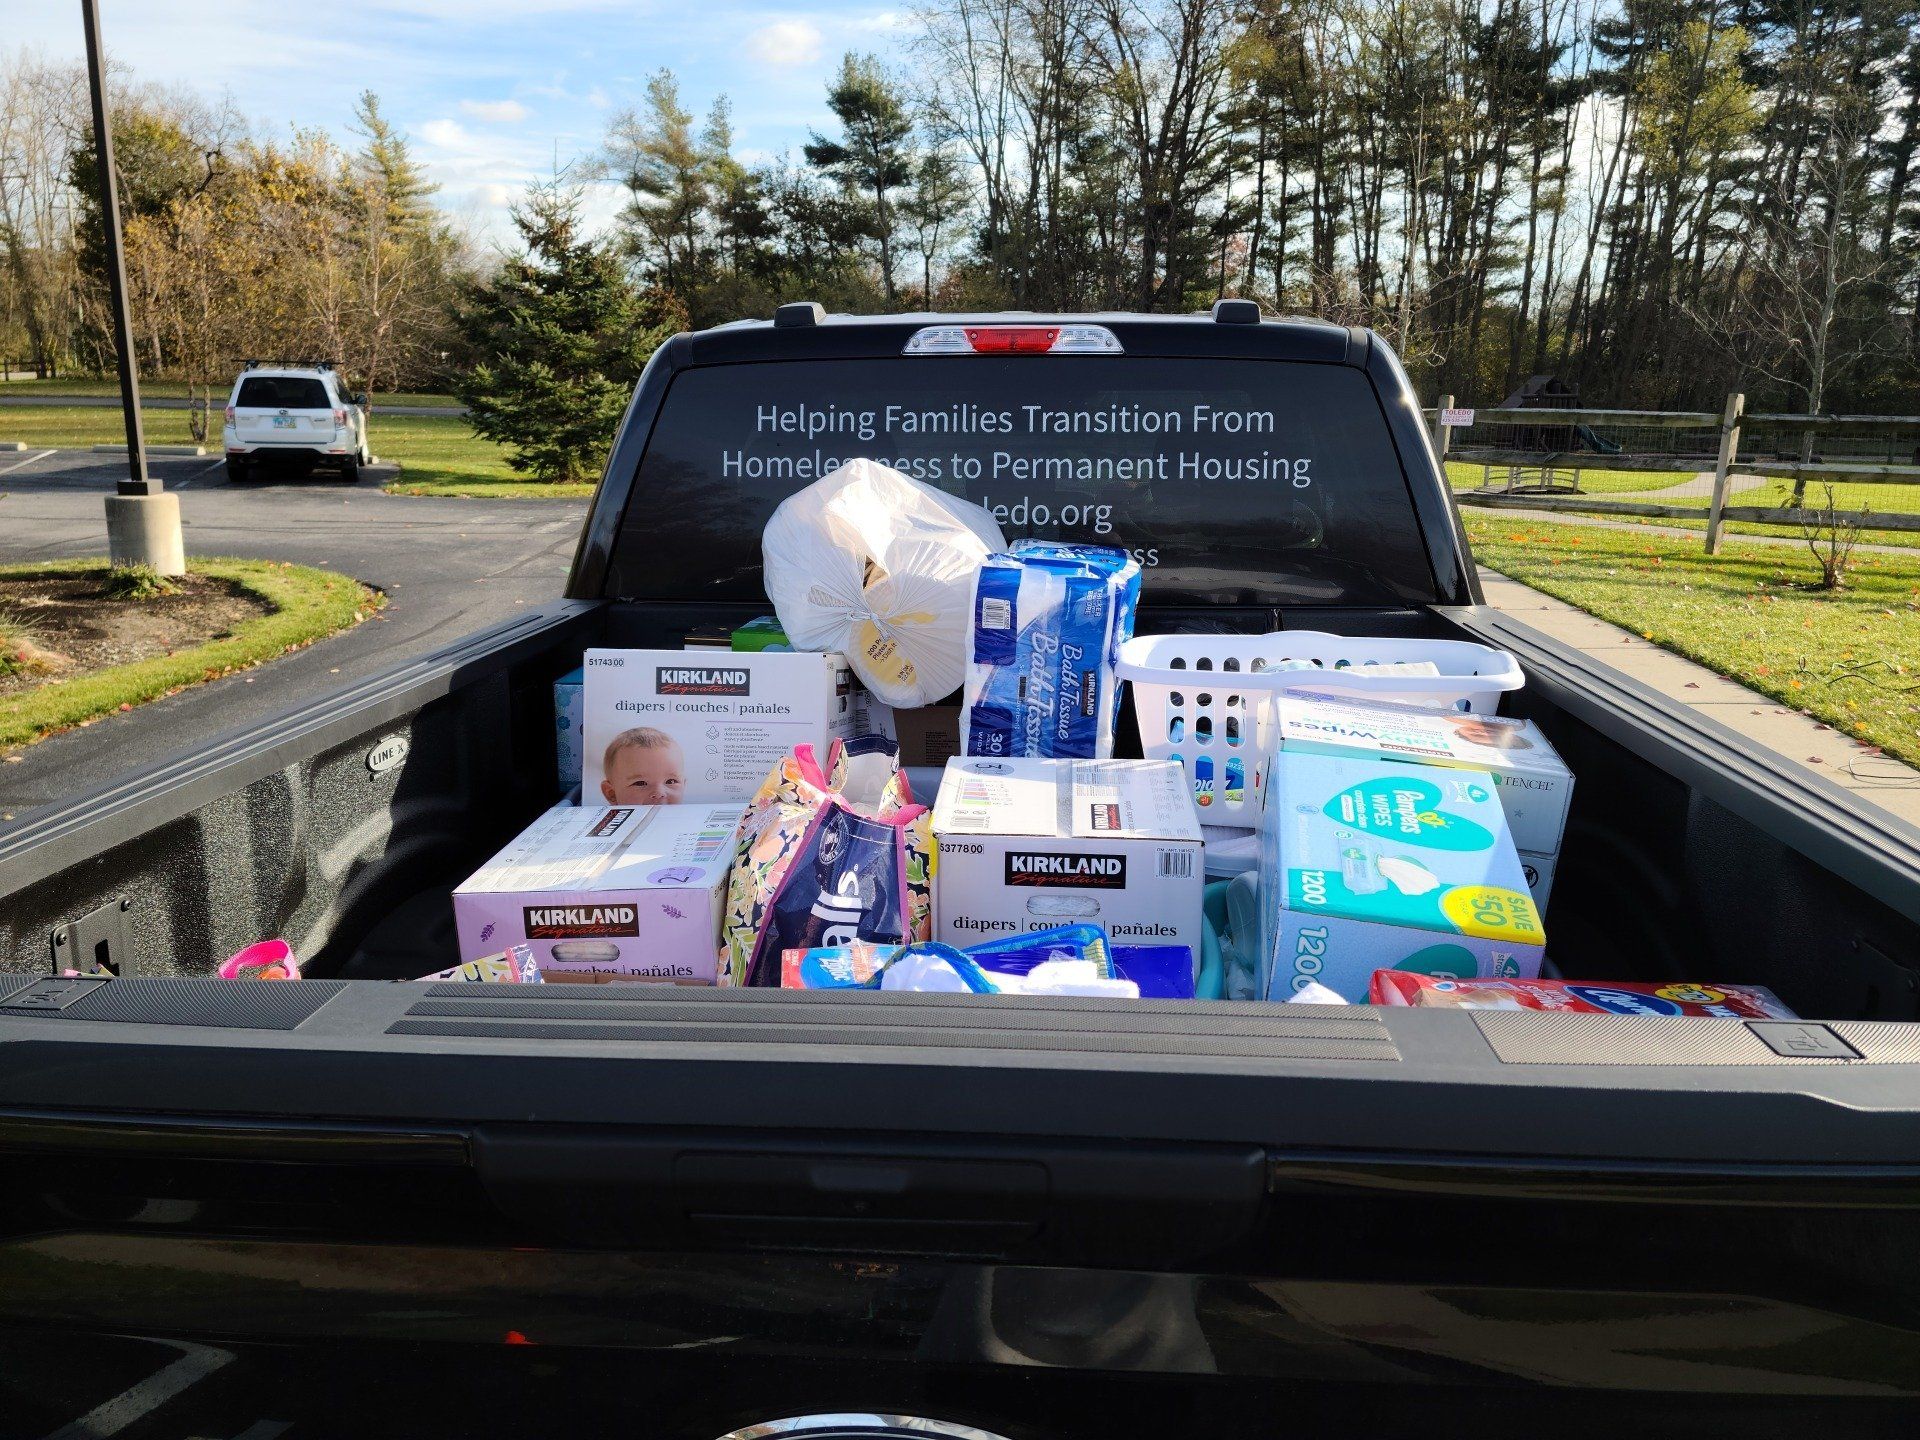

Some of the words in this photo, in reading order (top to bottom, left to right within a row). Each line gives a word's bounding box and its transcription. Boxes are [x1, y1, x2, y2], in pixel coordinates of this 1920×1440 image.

[757, 404, 876, 441] Helping
[885, 404, 1013, 433] Families
[1022, 404, 1181, 433] Transition
[1193, 405, 1275, 433] From
[723, 449, 942, 479] Homeleess
[951, 453, 982, 479] to
[992, 452, 1168, 479] Permanent
[1178, 451, 1311, 488] Housing
[1031, 631, 1059, 697] Bath
[1061, 644, 1083, 690] Bath
[661, 669, 747, 686] KIRKLAND
[660, 684, 747, 696] Signature
[1086, 673, 1097, 716] KIRKLAND
[615, 700, 665, 714] diapers
[675, 701, 729, 713] couches
[739, 702, 791, 715] pañales
[1058, 686, 1081, 740] Tissue
[991, 733, 1003, 753] 30
[1504, 776, 1553, 791] TENCEL
[1371, 794, 1393, 827] WIPES
[1392, 789, 1425, 835] Pampers
[1012, 856, 1122, 875] KIRKLAND
[1011, 872, 1121, 887] Signature
[1301, 870, 1327, 905] 1200
[530, 907, 635, 926] KIRKLAND
[1507, 896, 1535, 932] SAVE
[531, 924, 635, 940] Signature
[953, 917, 1016, 934] diapers
[1111, 922, 1178, 938] pañales
[631, 964, 693, 977] pañales
